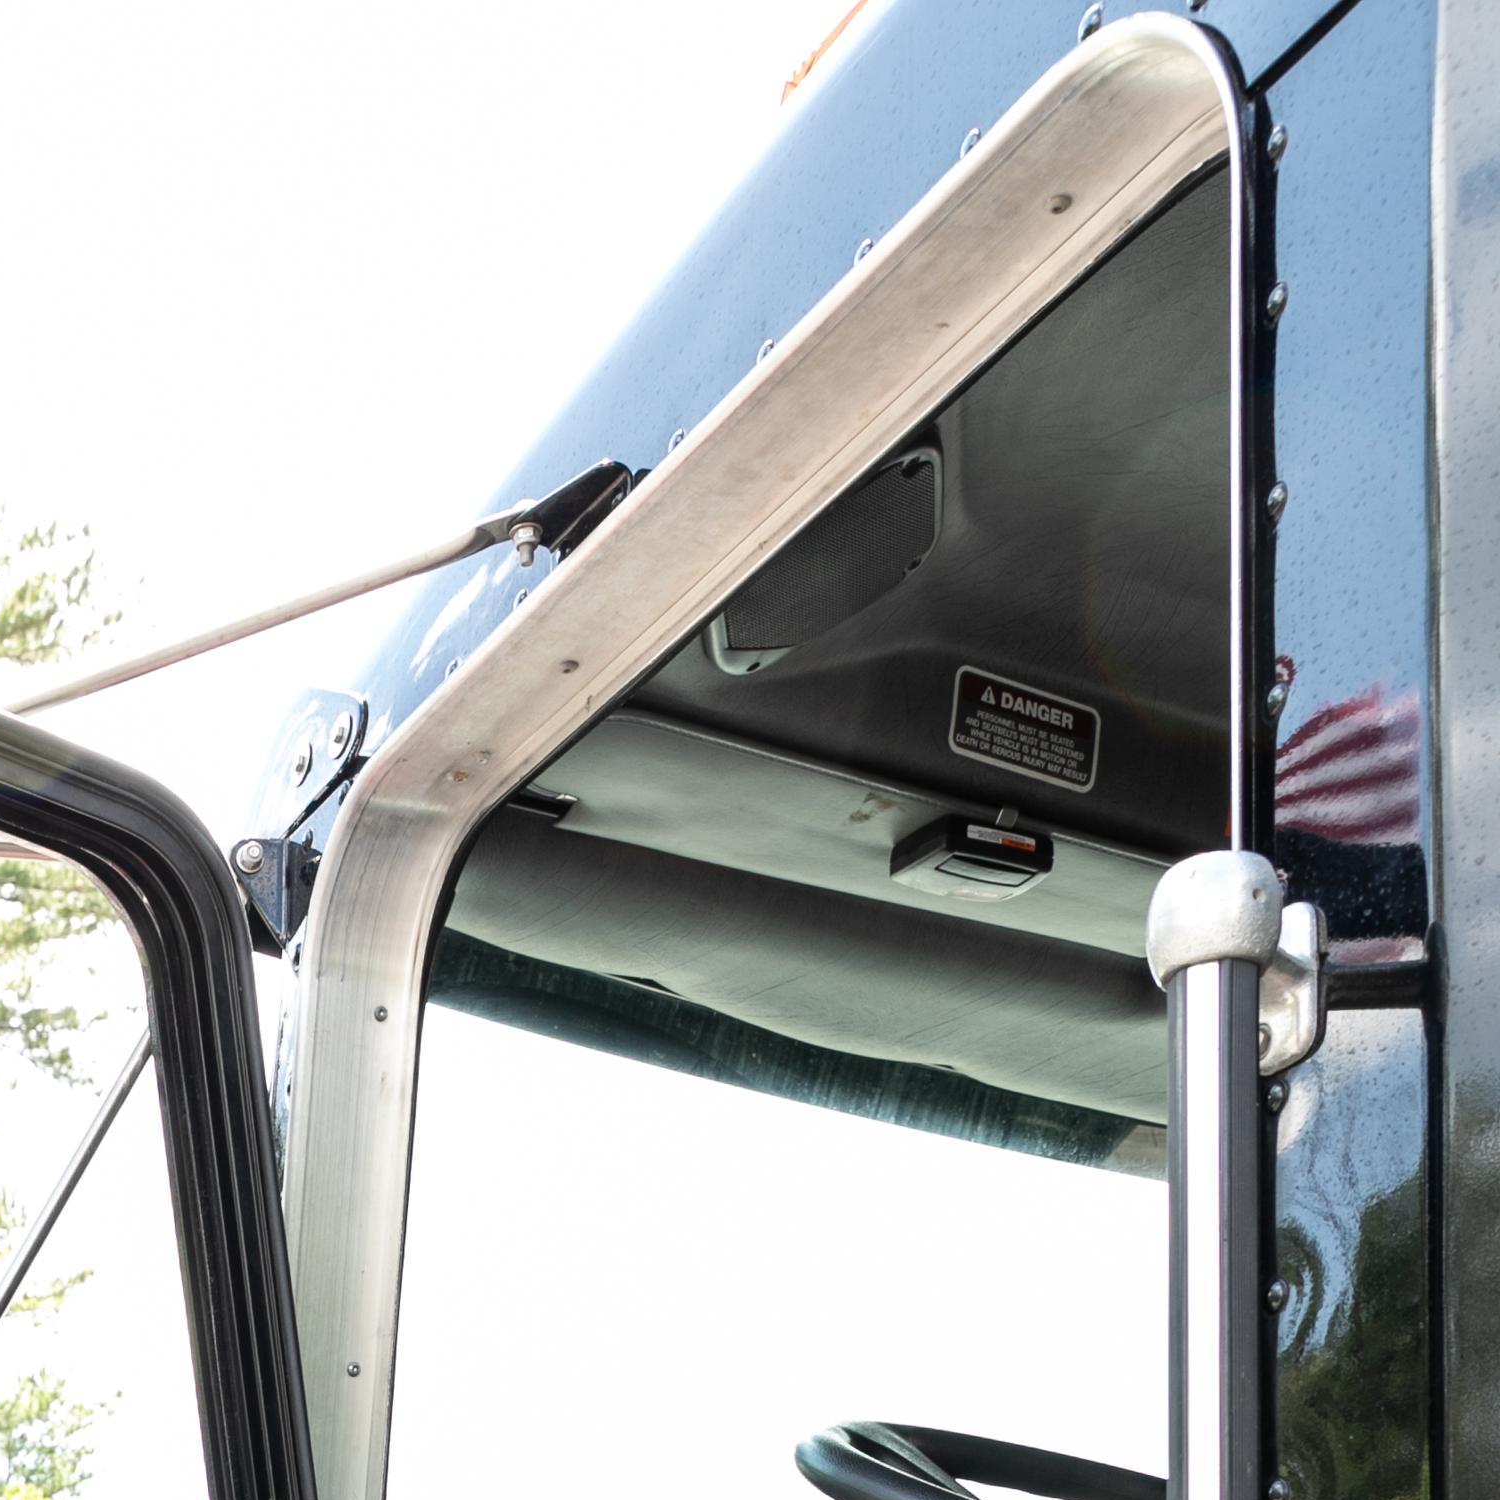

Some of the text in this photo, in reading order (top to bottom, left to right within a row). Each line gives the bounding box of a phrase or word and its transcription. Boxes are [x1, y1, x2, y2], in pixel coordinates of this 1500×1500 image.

[977, 709, 1076, 748] PERSONNEL MUST BE SEATED
[1000, 691, 1074, 730] DANGER
[955, 732, 1089, 782] DEATH OR SERIOUS INJURY MAY RESULT
[965, 716, 1085, 761] AND SEATBELTS MUST BE FASTENED
[969, 727, 1079, 769] WHILE VEHICLE IS IN MOTION OR
